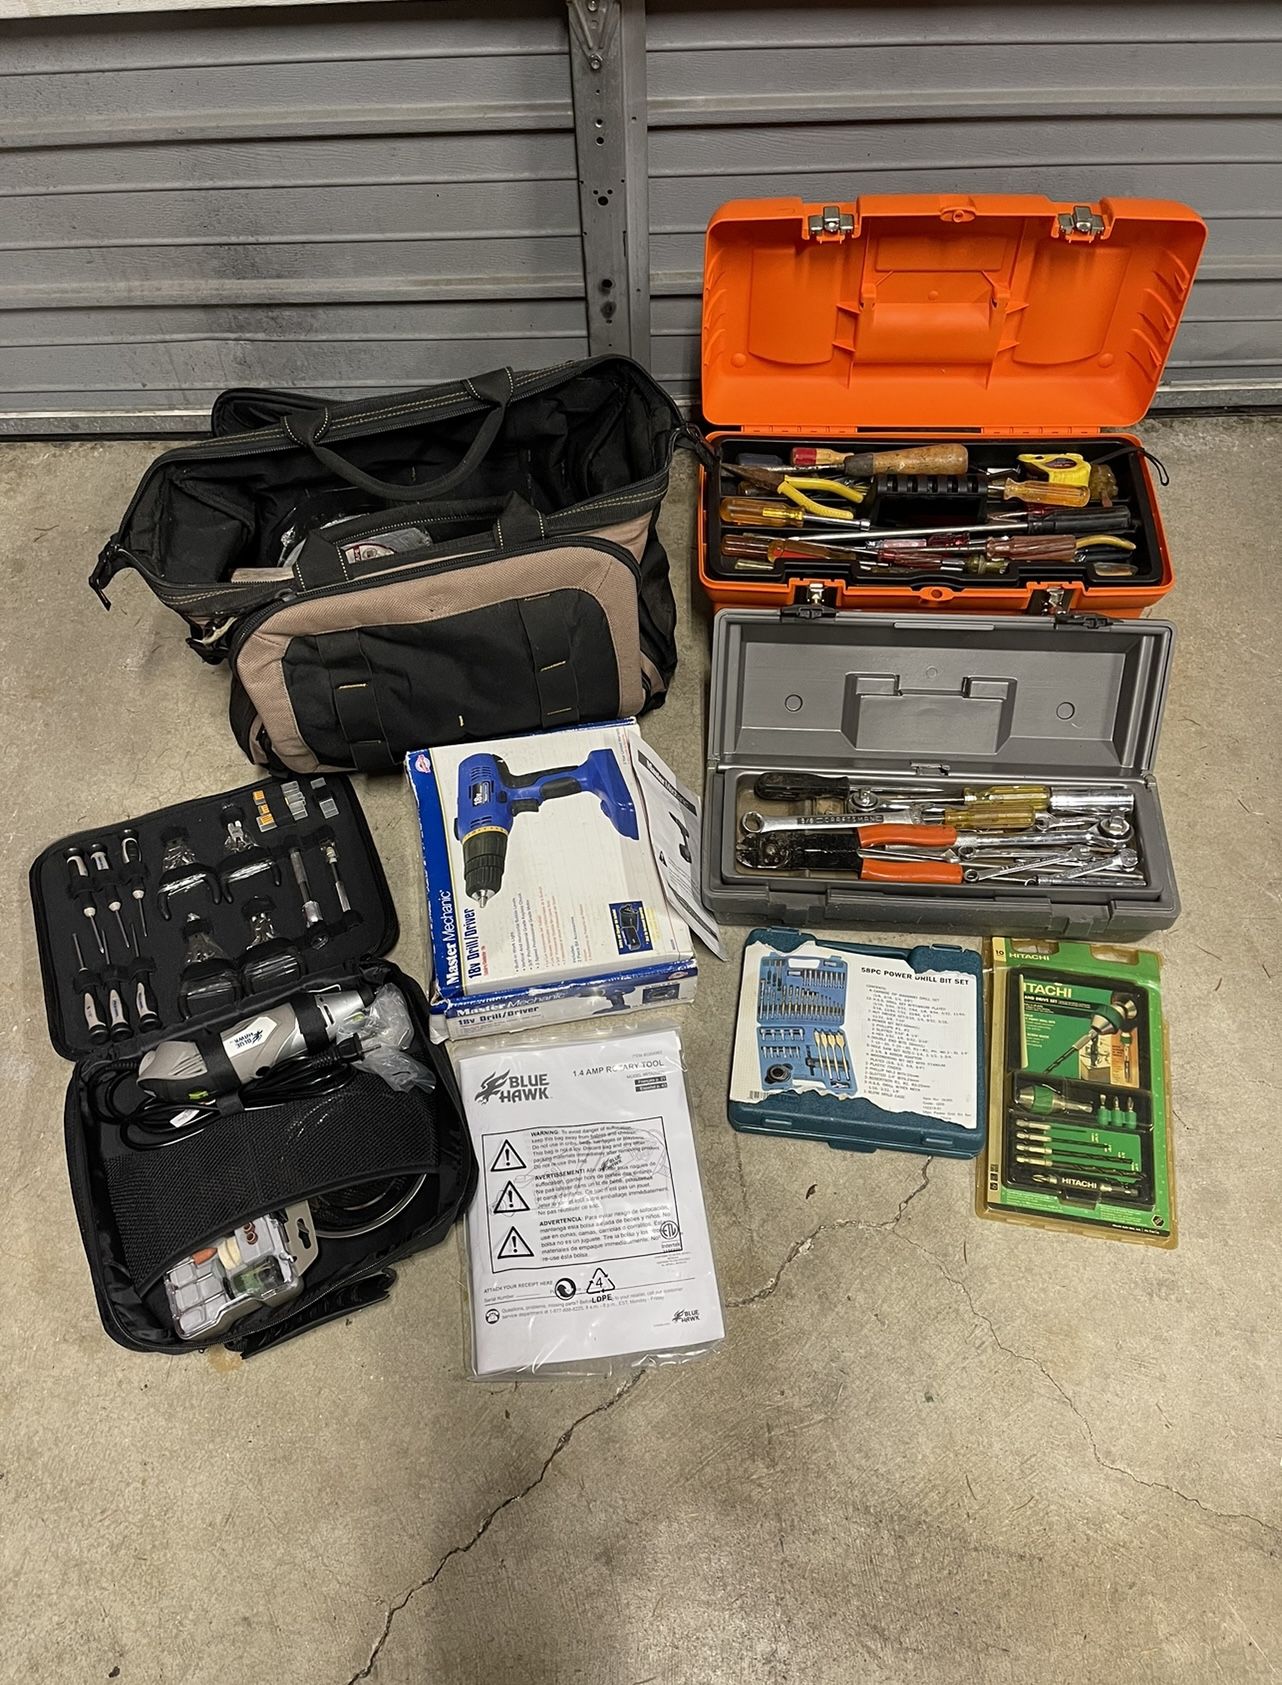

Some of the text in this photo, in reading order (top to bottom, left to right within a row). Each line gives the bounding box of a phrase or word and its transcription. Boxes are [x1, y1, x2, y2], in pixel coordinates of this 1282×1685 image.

[440, 890, 460, 986] Master Mechanic
[463, 908, 482, 979] 18v Drill/Driver
[1009, 952, 1050, 961] HITACHI
[860, 967, 881, 976] 58PC
[884, 970, 913, 980] POWER
[914, 975, 938, 984] DRILL
[1023, 982, 1072, 999] ITACHI
[456, 993, 562, 1018] Master Mechanic
[458, 1018, 476, 1027] 18v
[480, 1006, 539, 1021] Drill/Driver
[234, 1032, 254, 1043] HAWK
[235, 1038, 252, 1049] BLUE
[572, 1059, 664, 1078] 1.4 AMP ROARY TOOL
[509, 1073, 550, 1088] BLUE
[499, 1087, 549, 1103] HAWK
[1061, 1176, 1098, 1190] HITACHI
[540, 1216, 584, 1227] ADVERTENCIA:
[484, 1286, 503, 1294] ATTACH
[518, 1281, 539, 1289] RECEIPT
[596, 1277, 603, 1289] 4
[591, 1293, 613, 1304] LDPE
[684, 1309, 700, 1318] BLUE
